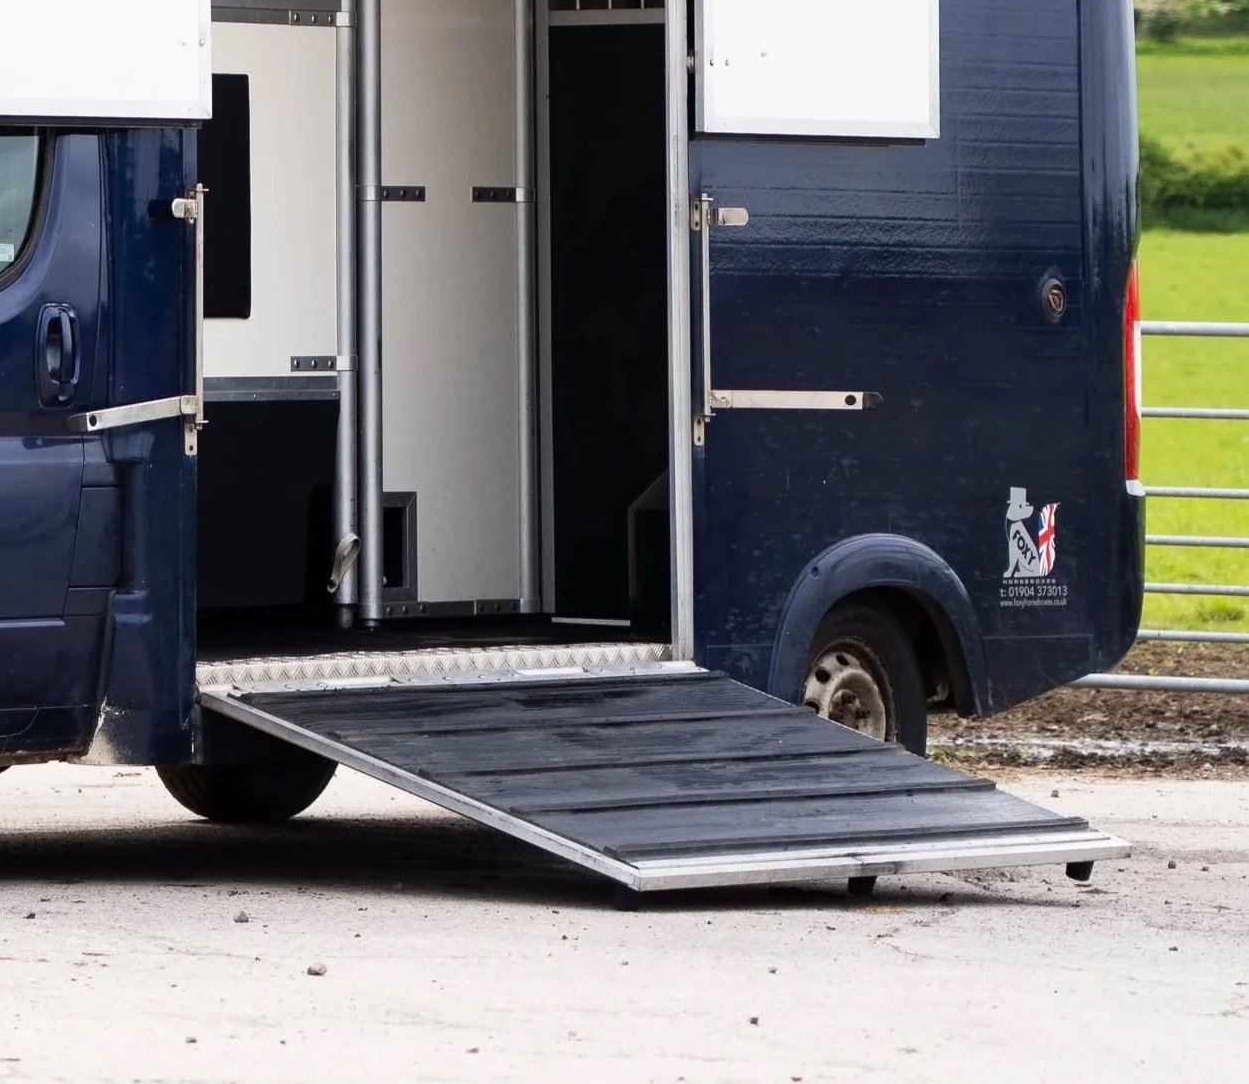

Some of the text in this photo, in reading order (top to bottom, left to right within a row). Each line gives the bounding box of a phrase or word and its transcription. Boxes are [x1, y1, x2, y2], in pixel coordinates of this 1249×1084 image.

[1012, 529, 1036, 565] FOXY
[1000, 585, 1068, 597] t: 01904 373013
